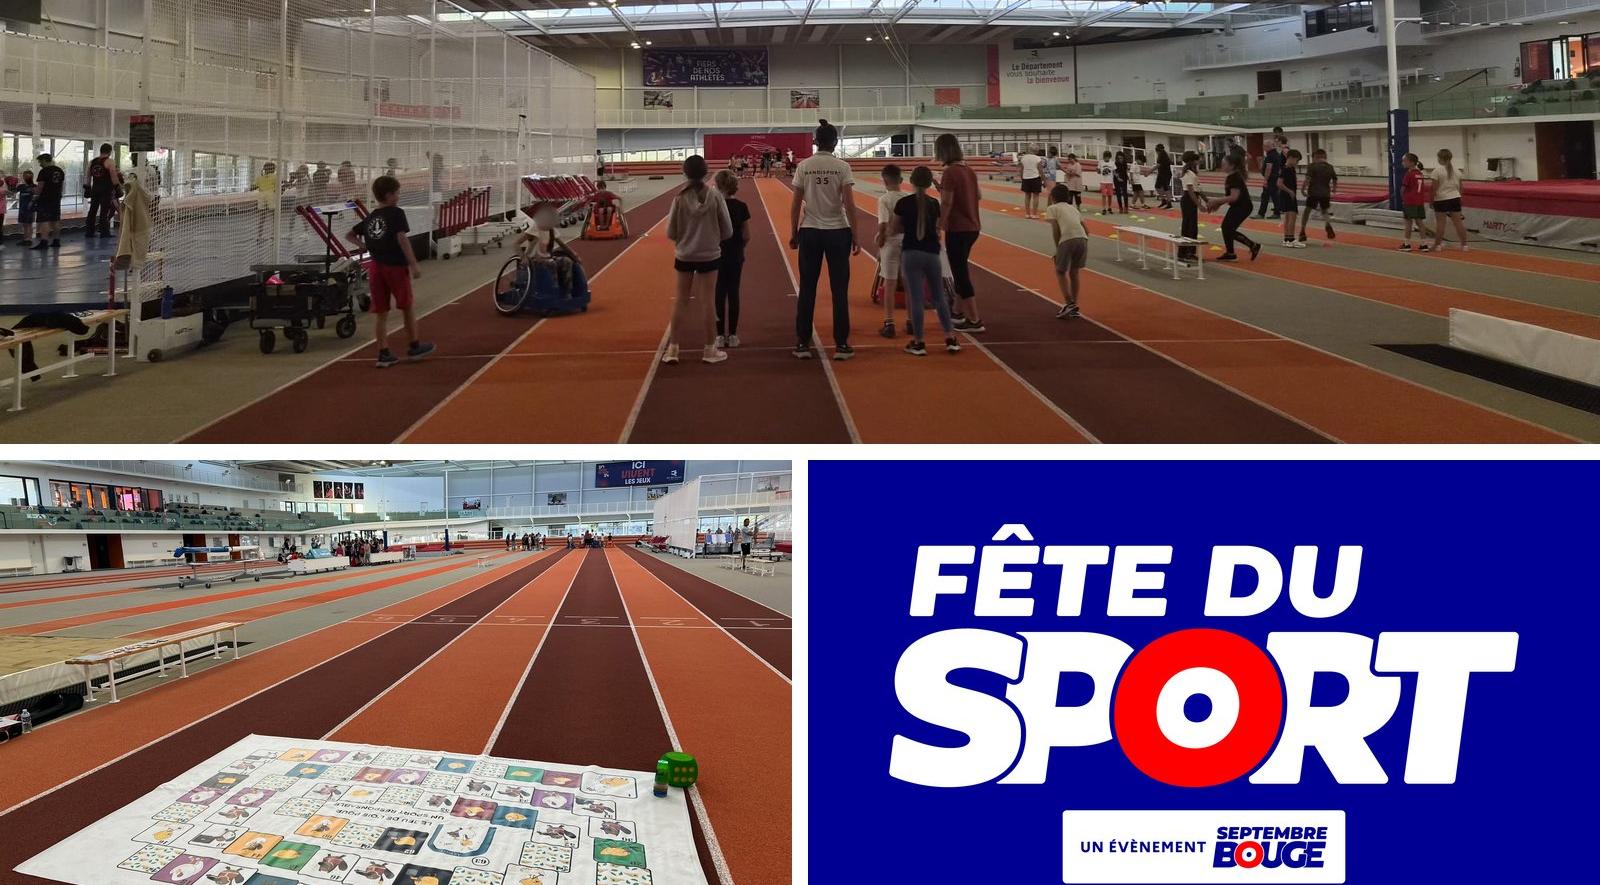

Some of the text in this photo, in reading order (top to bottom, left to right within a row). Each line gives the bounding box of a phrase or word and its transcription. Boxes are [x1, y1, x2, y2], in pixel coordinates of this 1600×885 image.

[1021, 61, 1063, 71] Département
[1025, 69, 1056, 77] souhaite
[1035, 76, 1070, 84] bienvenue
[816, 176, 829, 185] 35
[632, 460, 646, 469] ICI
[621, 468, 656, 479] VIVENT
[909, 524, 1363, 618] FÊTE DU
[889, 628, 1519, 788] SPORT
[400, 810, 428, 818] SPORT
[1216, 826, 1328, 840] SEPTEMBRE
[1080, 838, 1206, 853] UN ÉVÈNEMENT
[1213, 840, 1326, 869] BOUGE
